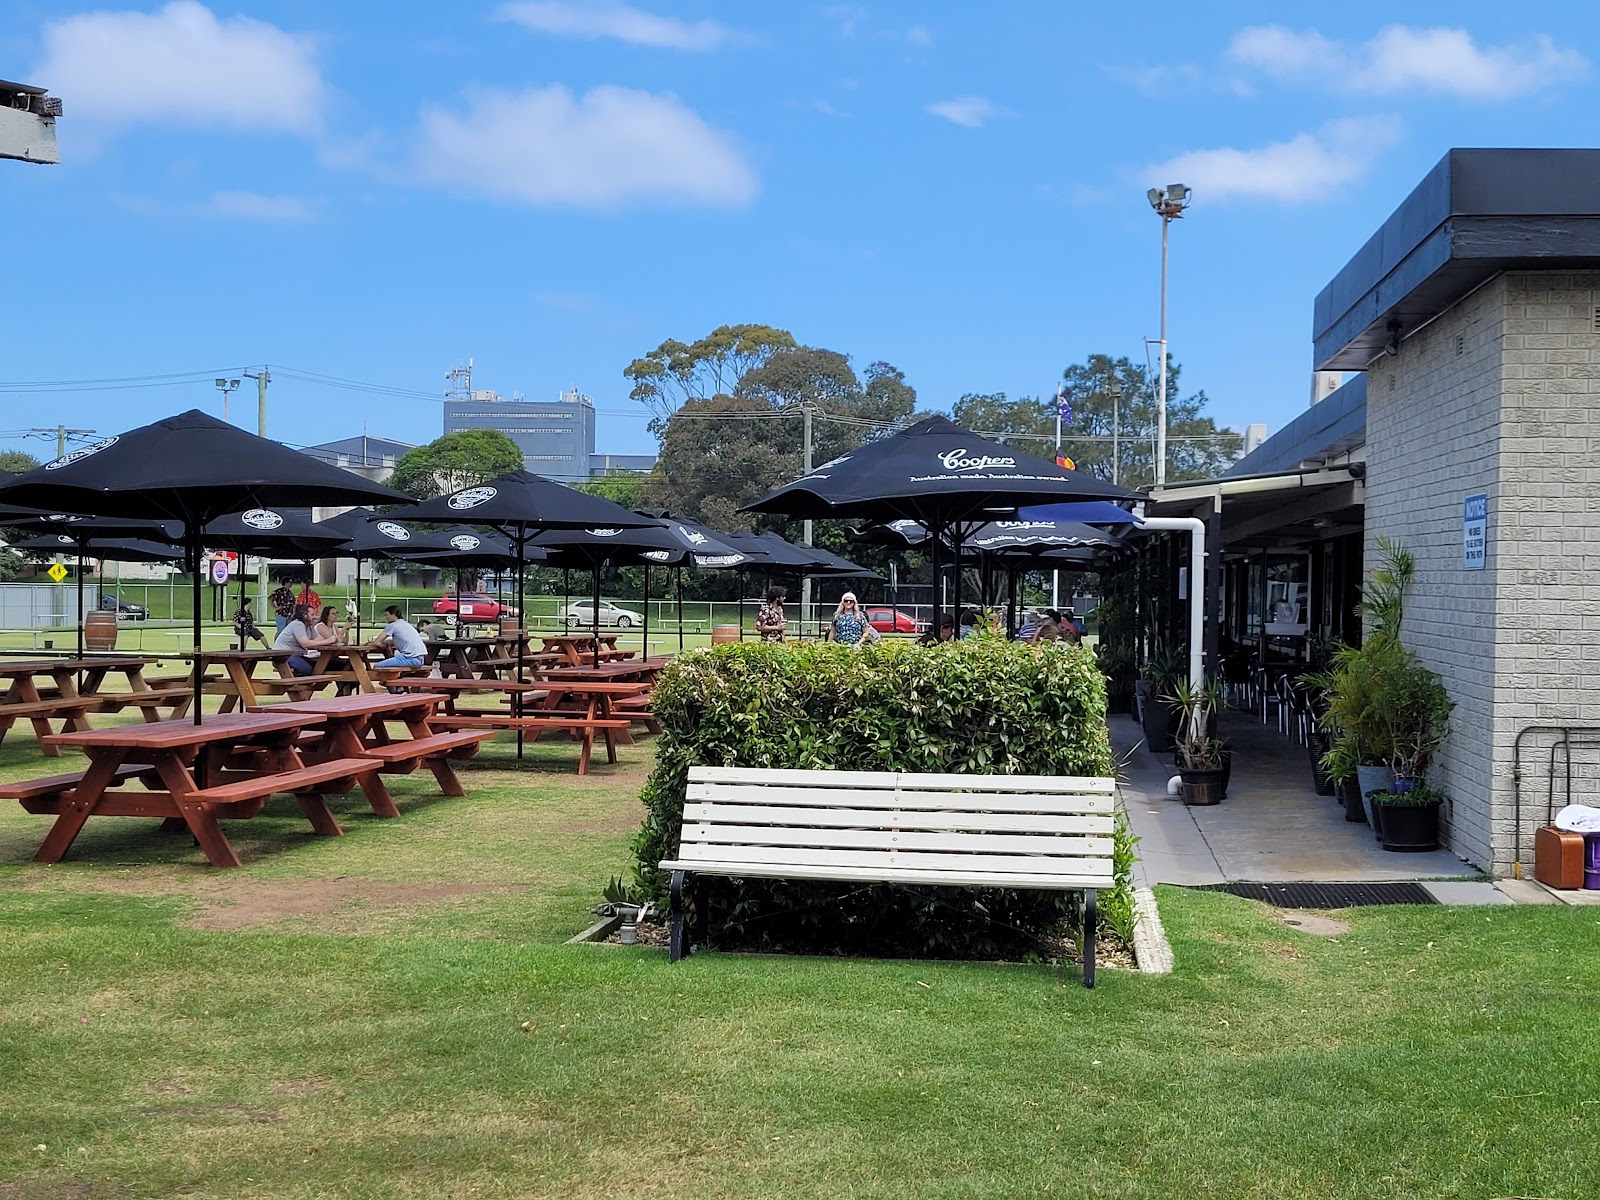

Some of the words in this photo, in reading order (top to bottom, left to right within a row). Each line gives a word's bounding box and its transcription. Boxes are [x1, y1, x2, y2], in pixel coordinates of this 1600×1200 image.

[938, 449, 1016, 472] Coopers
[910, 474, 959, 482] Australian
[1466, 498, 1485, 518] NOTICE
